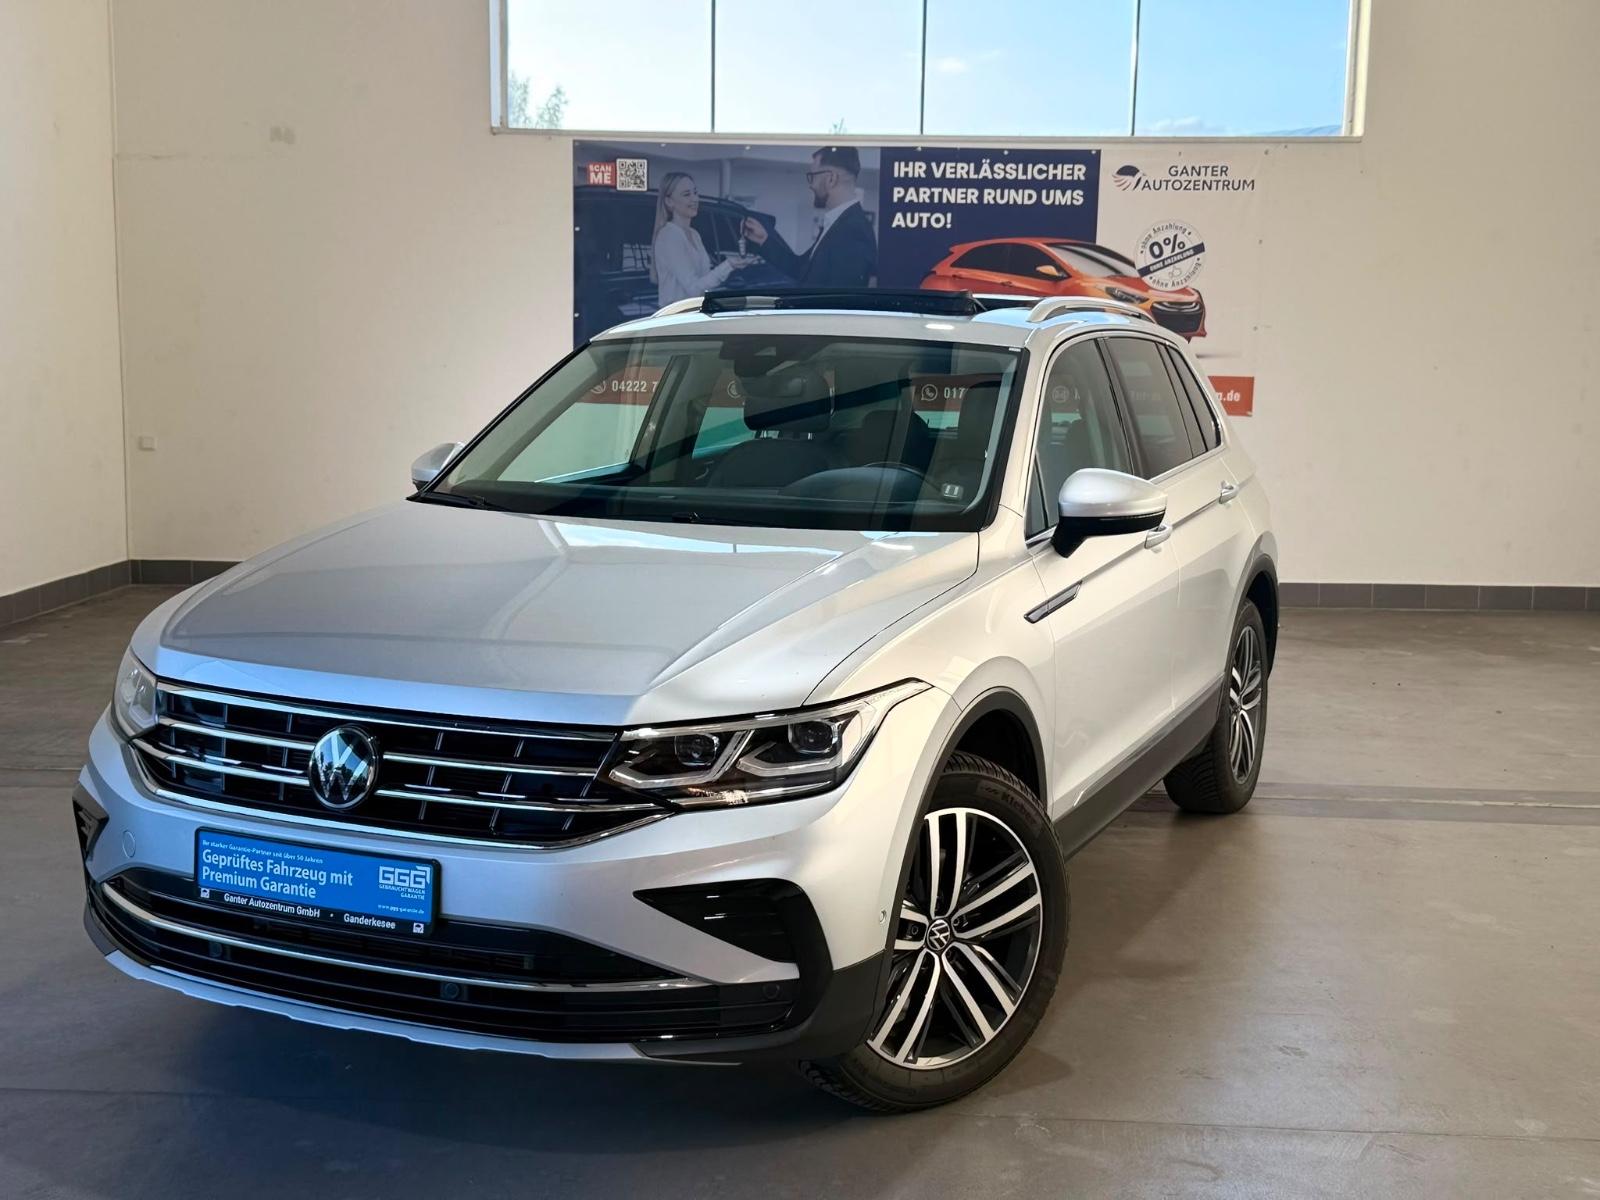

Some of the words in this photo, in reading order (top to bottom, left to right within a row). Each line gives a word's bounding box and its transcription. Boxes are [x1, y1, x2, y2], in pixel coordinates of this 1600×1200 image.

[589, 164, 612, 172] SCAN
[894, 161, 927, 178] IHR
[931, 158, 1087, 181] VERLÄSSLICHER
[1168, 165, 1229, 177] GANTER
[590, 173, 612, 185] ME
[1141, 179, 1255, 191] AUTOZENTRUM
[893, 187, 980, 204] PARTNER
[983, 188, 1037, 205] RUND
[1041, 189, 1085, 206] UMS
[891, 212, 952, 229] AUTO!
[1149, 233, 1186, 259] 0%
[611, 380, 648, 392] 04222
[943, 387, 969, 399] 017
[202, 849, 264, 872] Geprüftes
[266, 859, 327, 886] Fahrzeug
[330, 870, 353, 886] mit
[202, 866, 258, 889] Premium
[260, 876, 317, 898] Garantie
[223, 893, 247, 905] Ganter
[249, 897, 296, 914] Autozentrum
[296, 906, 321, 918] GmbH
[343, 913, 397, 930] Ganderkesee
